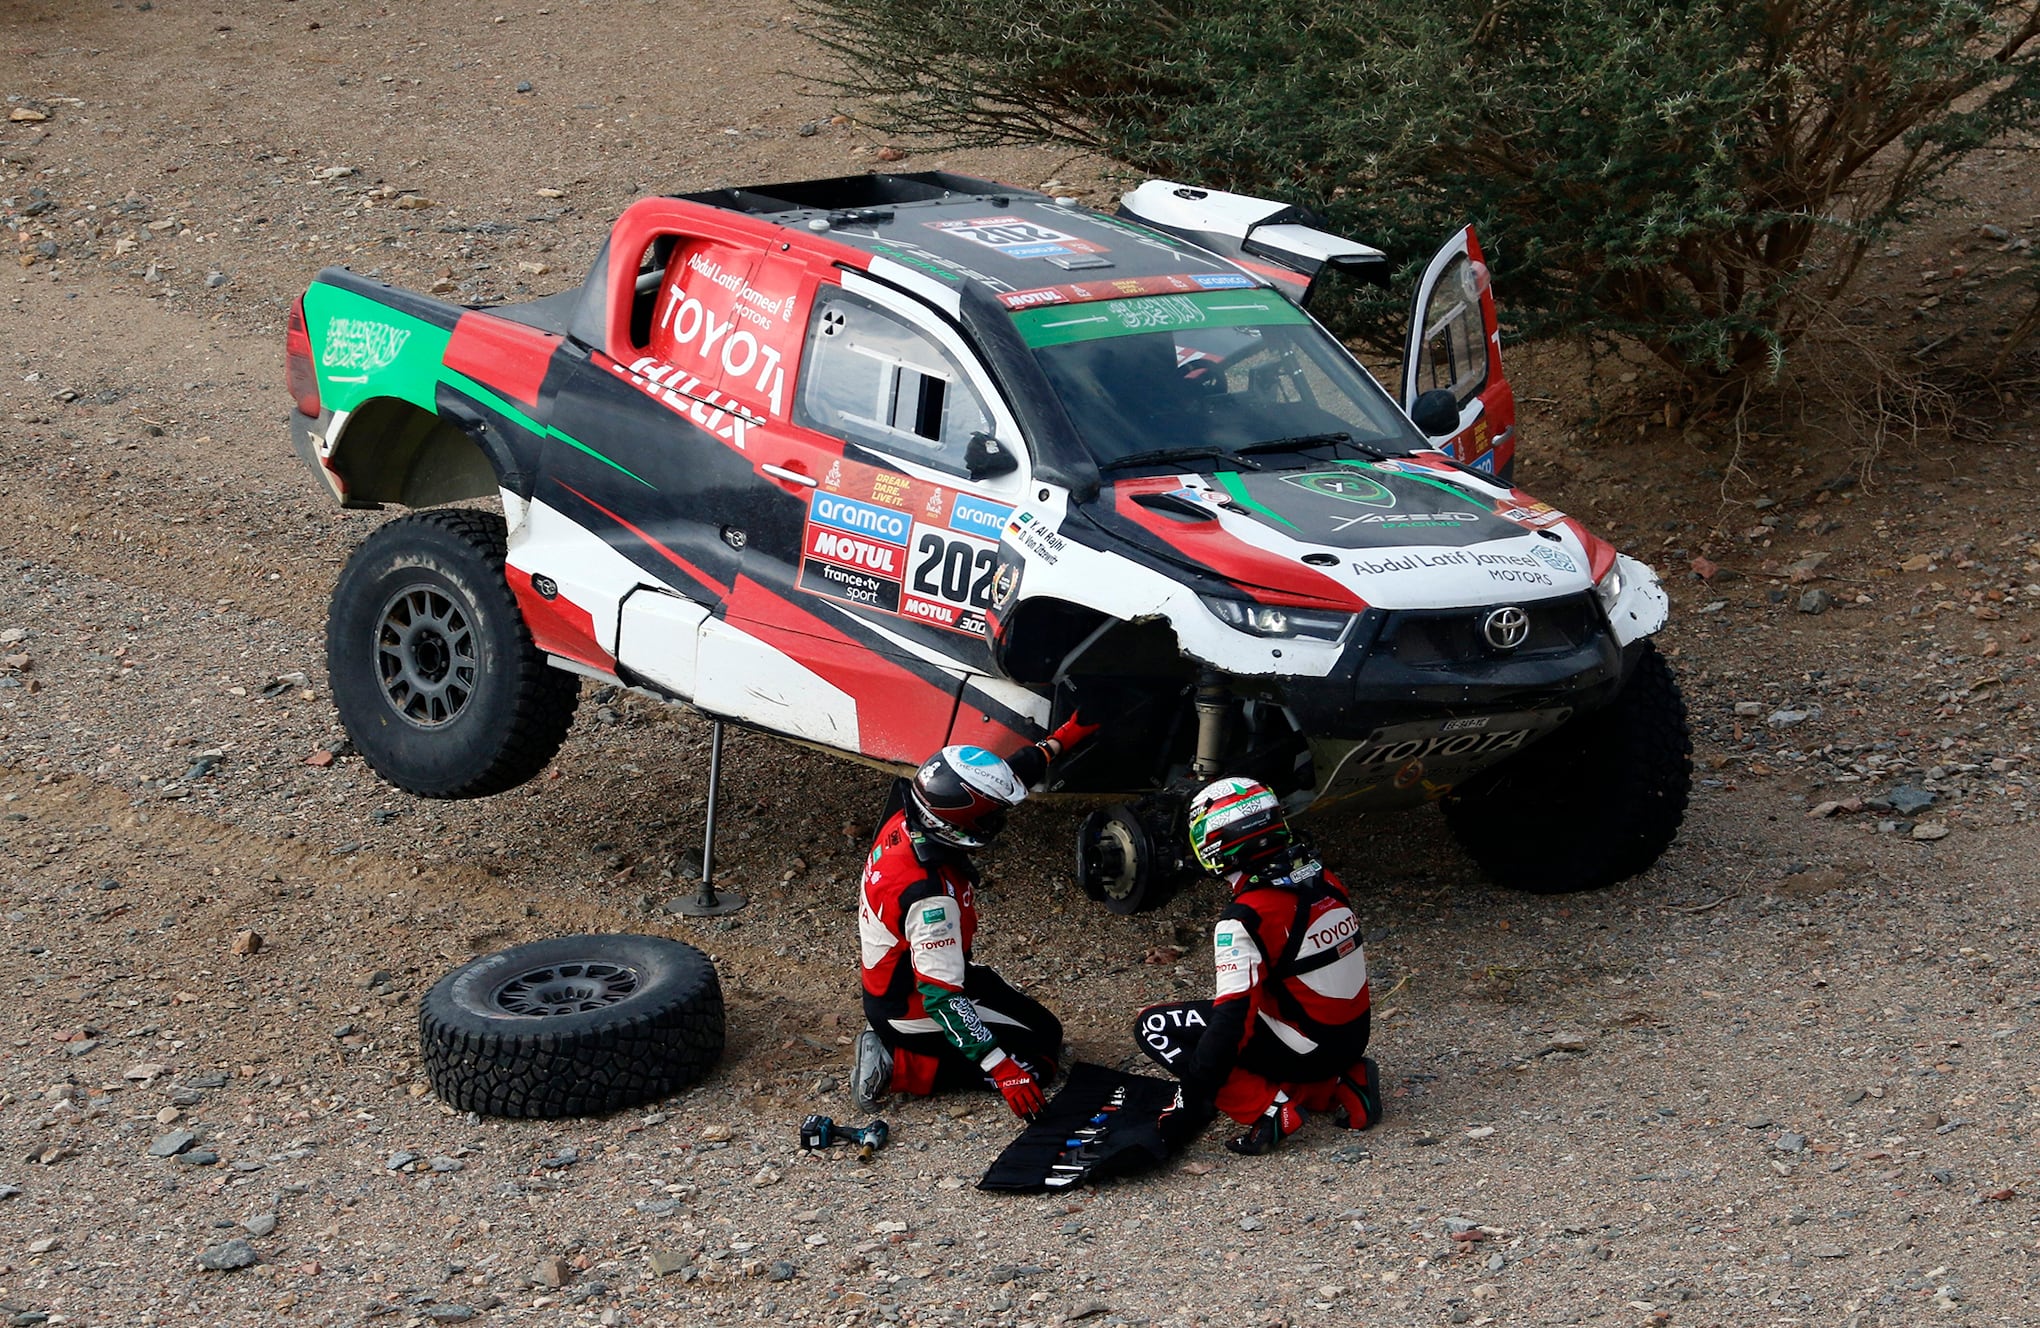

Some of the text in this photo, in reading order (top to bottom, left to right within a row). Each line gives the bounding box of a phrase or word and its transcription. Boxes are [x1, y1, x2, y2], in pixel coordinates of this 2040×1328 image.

[954, 224, 1061, 244] 202
[688, 253, 782, 315] Abdul Latif Jameel
[1199, 275, 1247, 288] aramco
[1007, 290, 1061, 306] MOTUL
[733, 302, 772, 330] MOTORS
[661, 284, 784, 416] TOYOTA
[873, 483, 900, 496] DARE.
[876, 473, 910, 489] DREAM.
[872, 491, 891, 503] LIVE
[819, 500, 903, 536] aramco
[956, 506, 1007, 529] aramc
[1330, 512, 1479, 532] YAZEED
[1381, 521, 1461, 529] RACING
[1035, 526, 1049, 537] Al
[1044, 532, 1067, 552] Rajhi
[814, 532, 894, 572] MOTUL
[1352, 551, 1540, 575] Abdul Latif Jameel
[913, 533, 998, 610] 202
[1489, 569, 1552, 585] MOTORS
[846, 586, 878, 603] sport
[904, 599, 953, 622] MOTUL
[1361, 729, 1530, 766] TOYOTA
[1308, 914, 1358, 949] TOYOTA
[921, 938, 956, 950] TOYOTA
